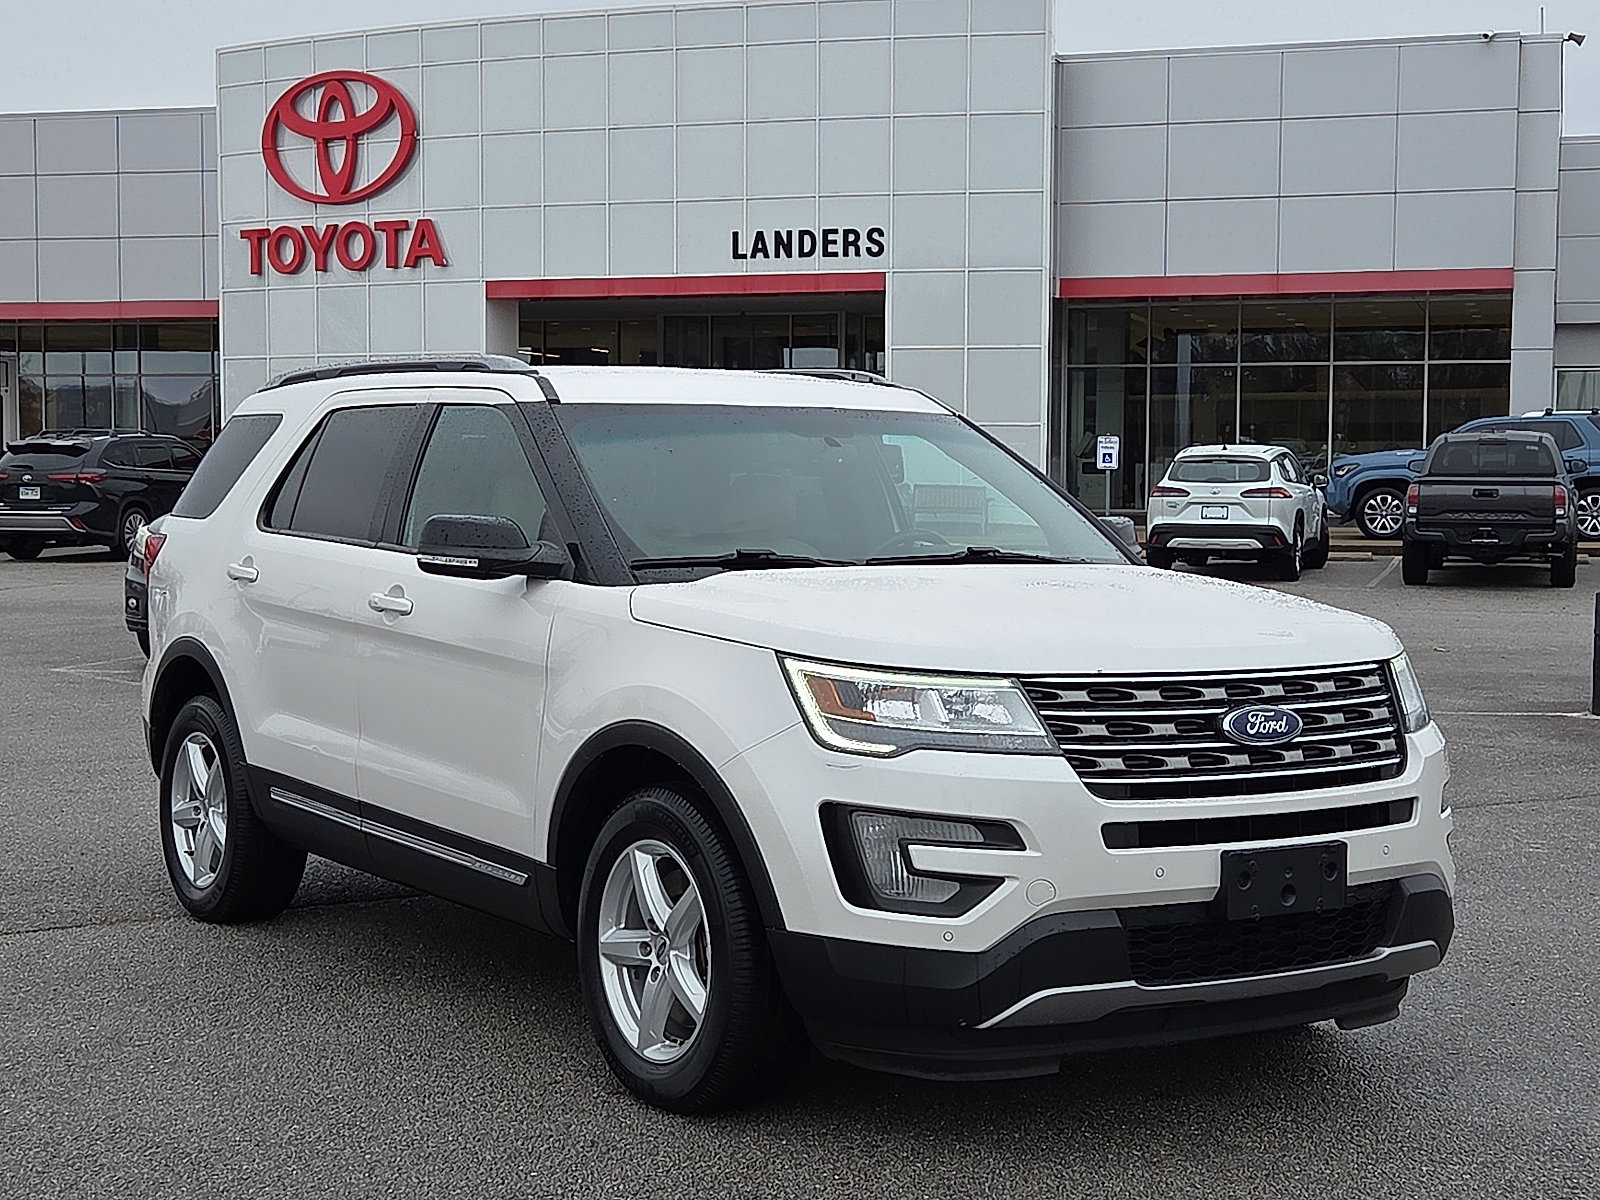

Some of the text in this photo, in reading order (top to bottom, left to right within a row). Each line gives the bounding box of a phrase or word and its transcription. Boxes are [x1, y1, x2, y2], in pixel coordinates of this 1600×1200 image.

[240, 218, 447, 275] TOYOTA
[732, 227, 885, 260] LANDERS
[1446, 512, 1528, 520] TACOMA
[1247, 711, 1288, 735] Ford
